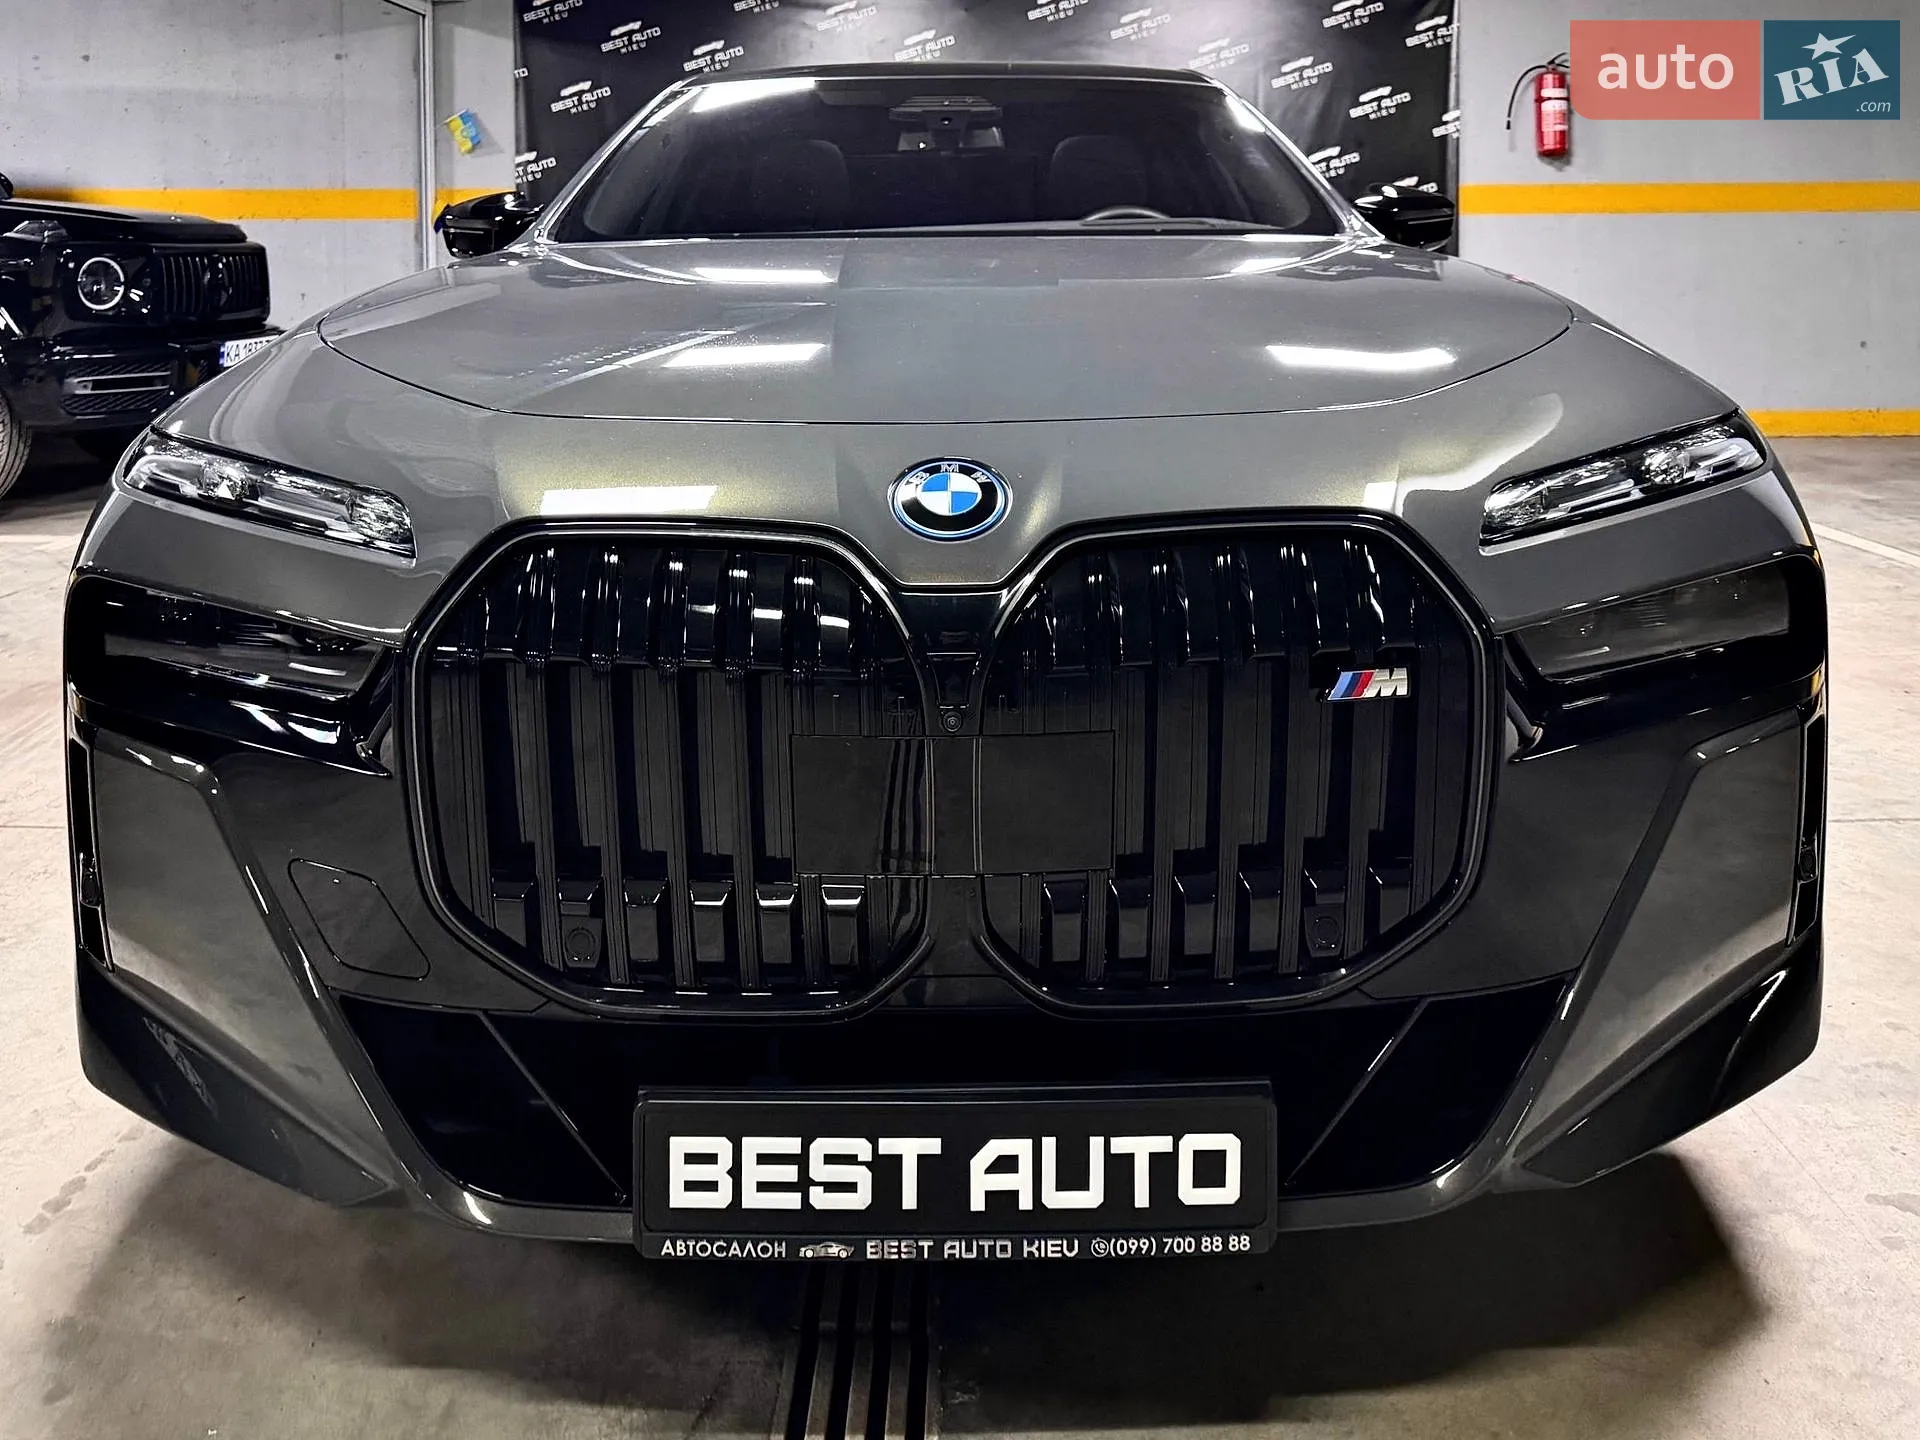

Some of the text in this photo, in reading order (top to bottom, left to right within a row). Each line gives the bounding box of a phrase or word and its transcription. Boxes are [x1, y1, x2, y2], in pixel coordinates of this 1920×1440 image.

[523, 0, 583, 22] BEST AUTO
[847, 5, 878, 21] AUTO
[1027, 3, 1057, 20] BEST
[1322, 2, 1384, 28] BEST AUTO
[1110, 13, 1172, 40] BEST AUTO
[600, 26, 661, 52] BEST AUTO
[924, 34, 956, 51] AUTO
[1405, 30, 1434, 47] BEST
[683, 46, 744, 72] BEST AUTO
[1219, 43, 1250, 59] AUTO
[513, 67, 529, 78] TO
[1271, 62, 1333, 88] BEST AUTO
[550, 86, 611, 113] BEST AUTO
[1349, 92, 1411, 118] BEST AUTO
[526, 157, 557, 173] AUTO
[1329, 152, 1360, 169] AUTO
[669, 1133, 1242, 1212] BEST AUTO
[660, 1238, 786, 1259] АВТОСАЛОН
[866, 1233, 1251, 1259] BEST AUTO KIEV (099) 700 88 88
